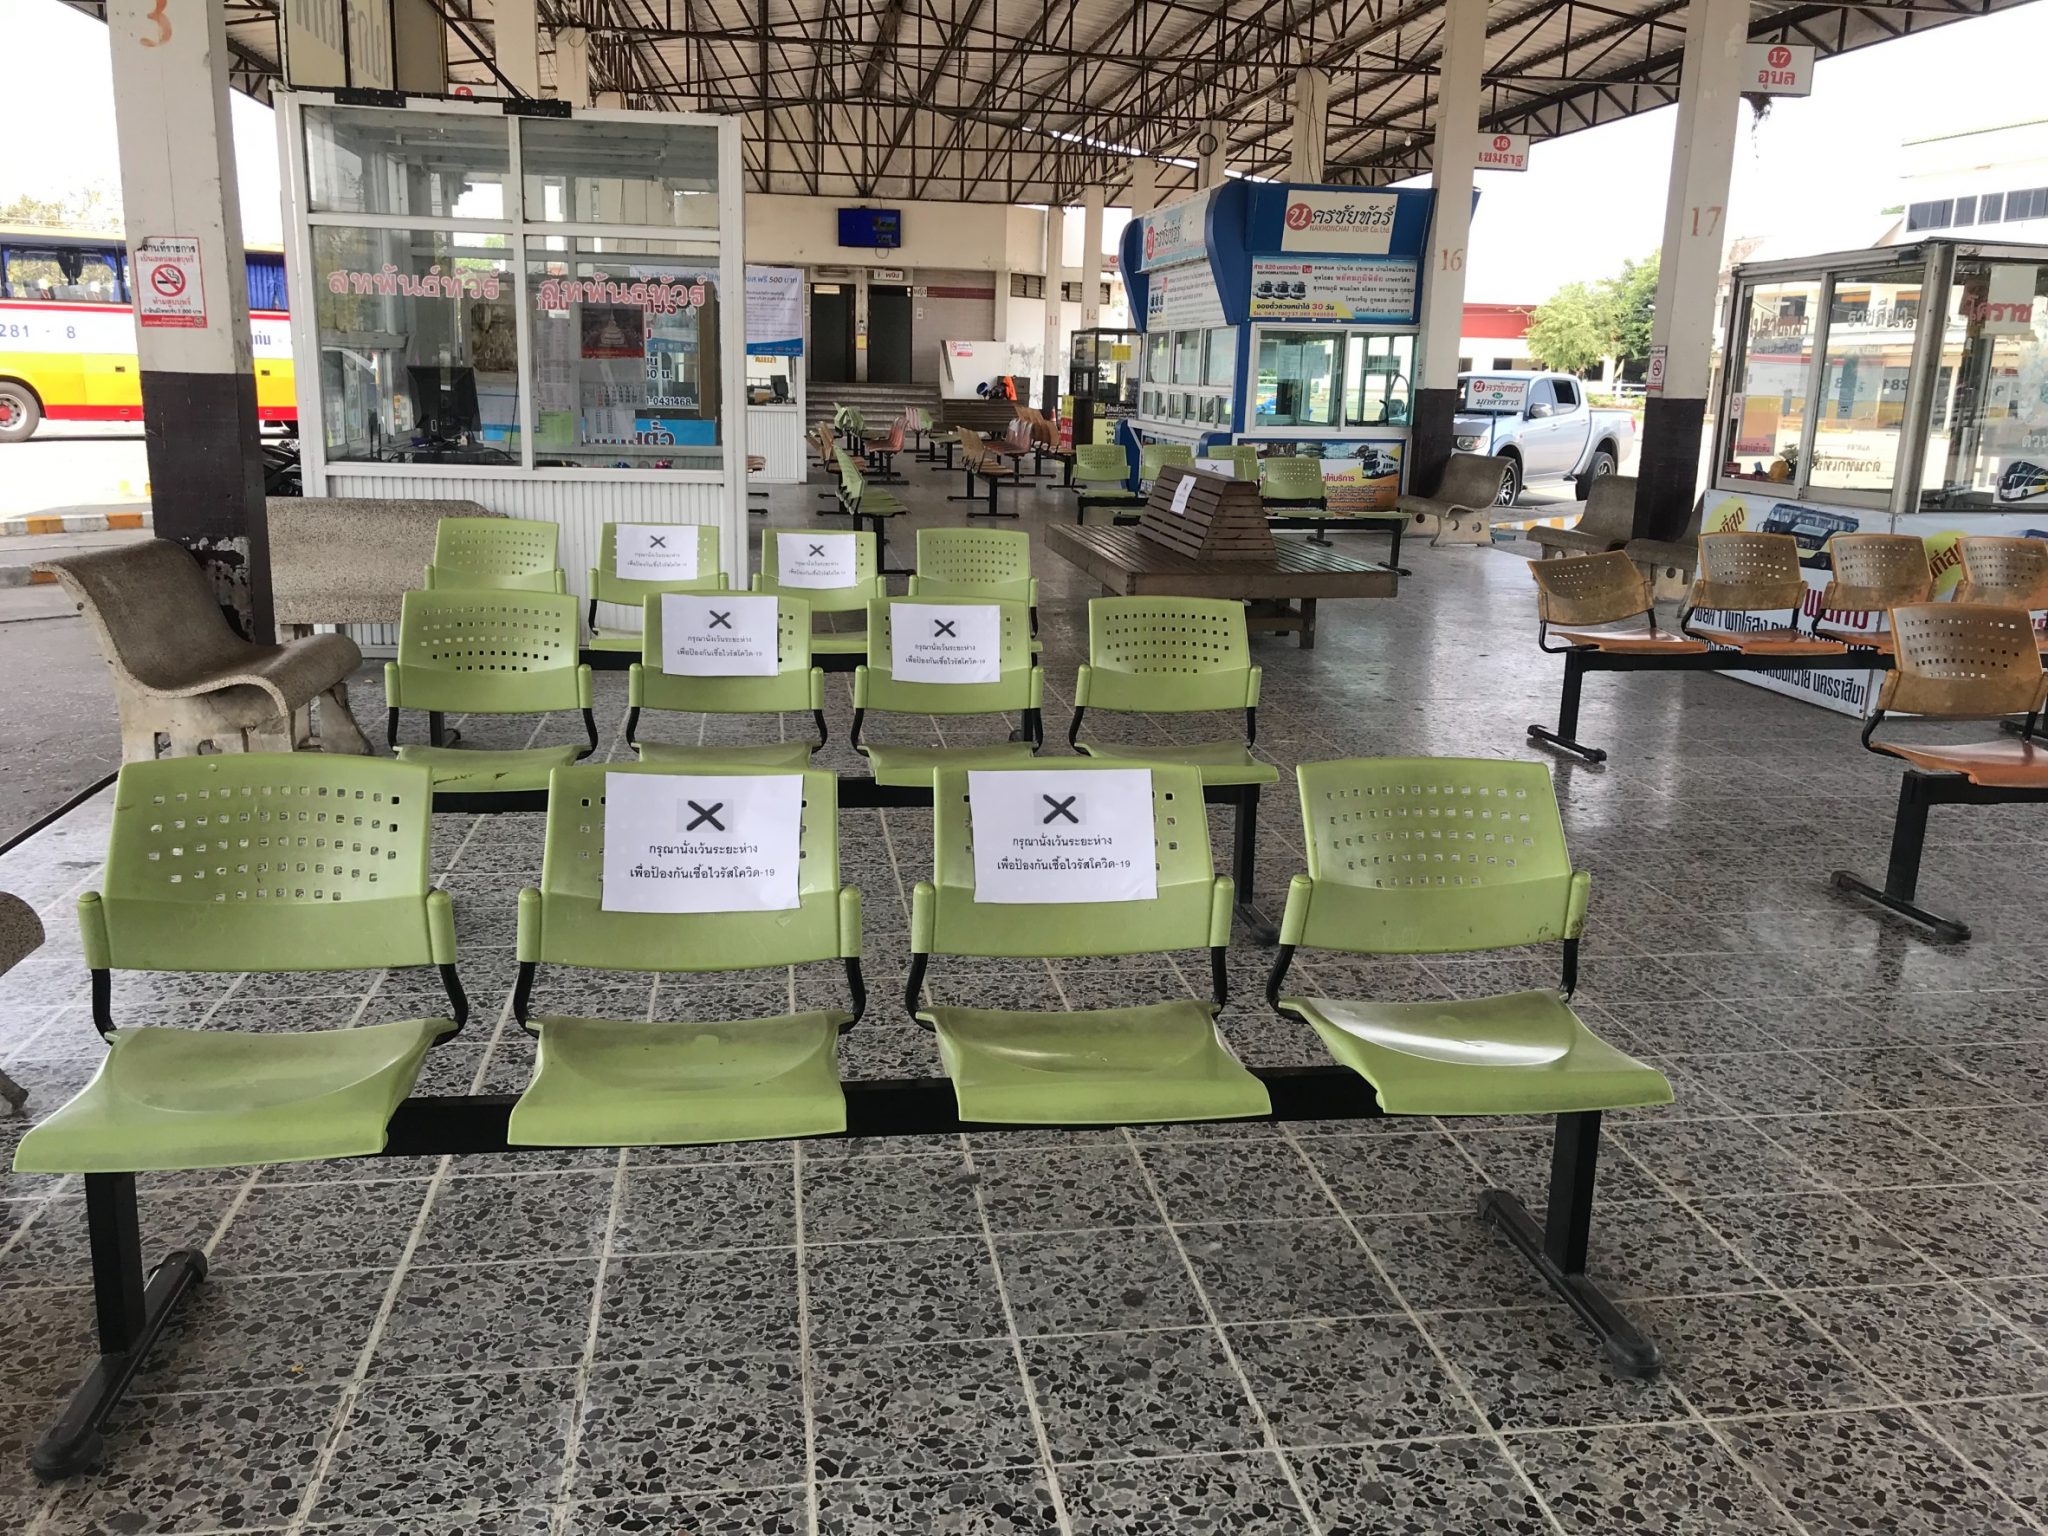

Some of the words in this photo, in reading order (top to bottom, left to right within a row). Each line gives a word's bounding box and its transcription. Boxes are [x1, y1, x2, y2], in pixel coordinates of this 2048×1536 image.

[140, 0, 173, 47] 3
[1771, 52, 1789, 64] 17
[1758, 70, 1796, 90] อุบล
[1496, 138, 1509, 148] 16
[1478, 151, 1524, 167] เขมราฐ
[1352, 225, 1369, 233] TOUR
[1692, 206, 1722, 237] 17
[1441, 248, 1464, 272] 16
[769, 275, 783, 284] 500
[0, 324, 30, 338] 281
[66, 325, 77, 339] 8
[649, 840, 758, 858] กรุณานั่งเว้นระยะห่าง
[1012, 833, 1113, 850] กรุณานั่งเว้นระยะห่าง
[630, 863, 775, 879] เพื่อป้องกันเชื้อไวรัสโควิด-19
[997, 855, 1131, 871] เพื่อป้องกันเชื้อไวรัสโควิด-19
